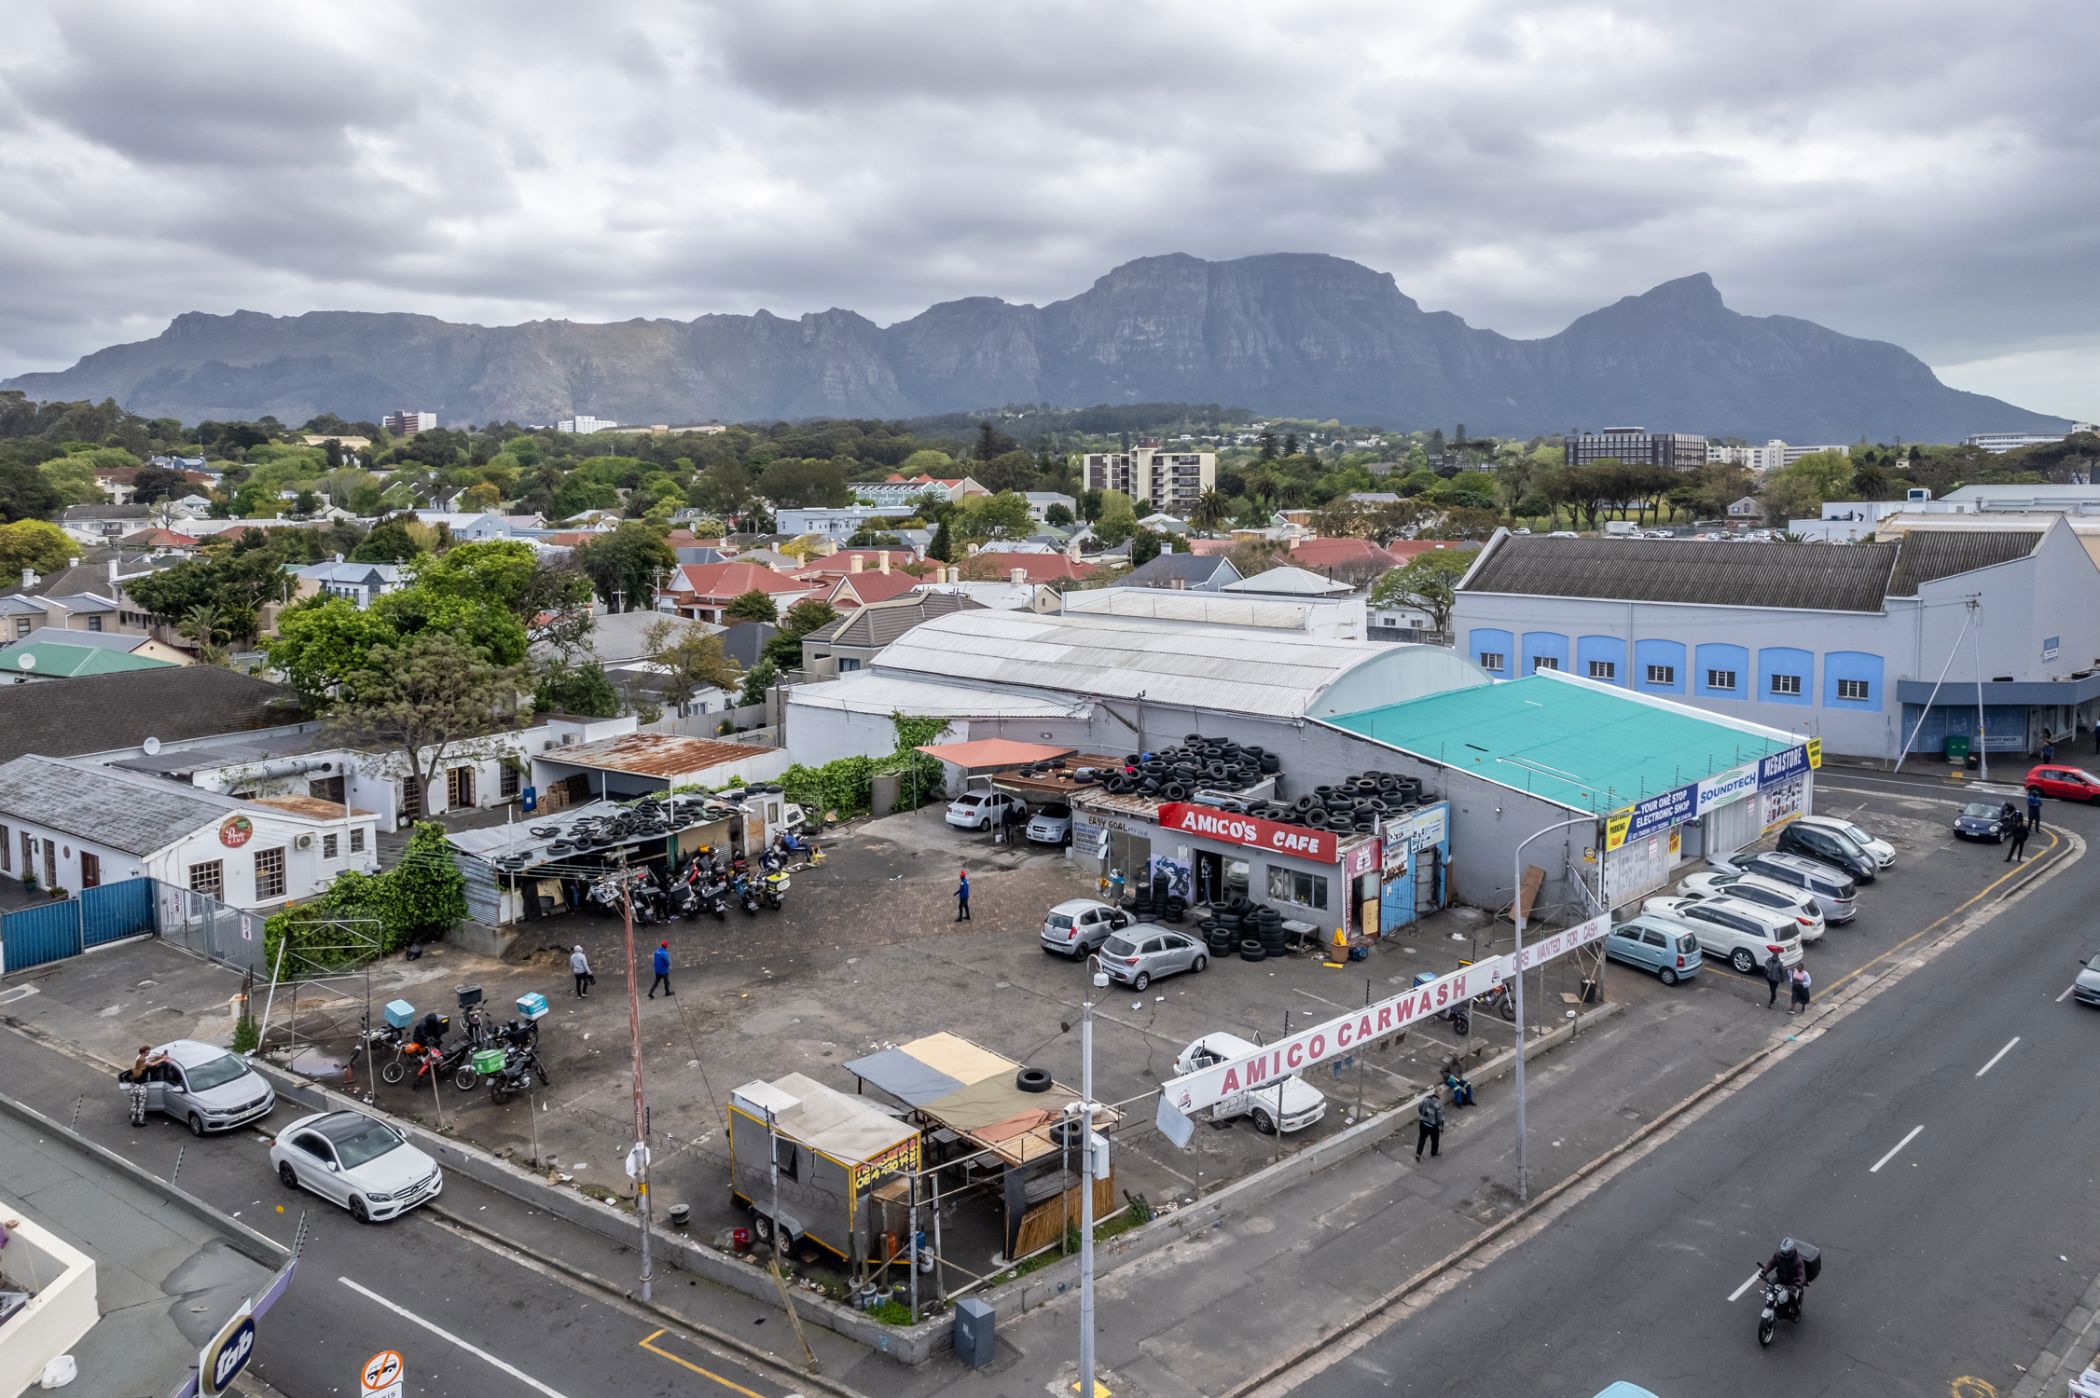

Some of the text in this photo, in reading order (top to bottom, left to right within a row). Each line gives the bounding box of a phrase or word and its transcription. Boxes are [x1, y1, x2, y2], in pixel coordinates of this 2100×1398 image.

[1763, 747, 1803, 778] MEGASTORE
[1641, 789, 1688, 815] YOUR ONE STOP
[1700, 772, 1756, 804] SOUNDTECH
[1088, 816, 1106, 827] EASY
[1109, 821, 1128, 832] GOAL
[1636, 806, 1673, 828] ELECTRONIC
[1674, 800, 1690, 814] SHOP
[1181, 811, 1320, 854] AMICO'S CAFE
[1513, 920, 1598, 972] CRS WANTED FOR CASH
[1220, 975, 1467, 1096] AMICO CARWASH
